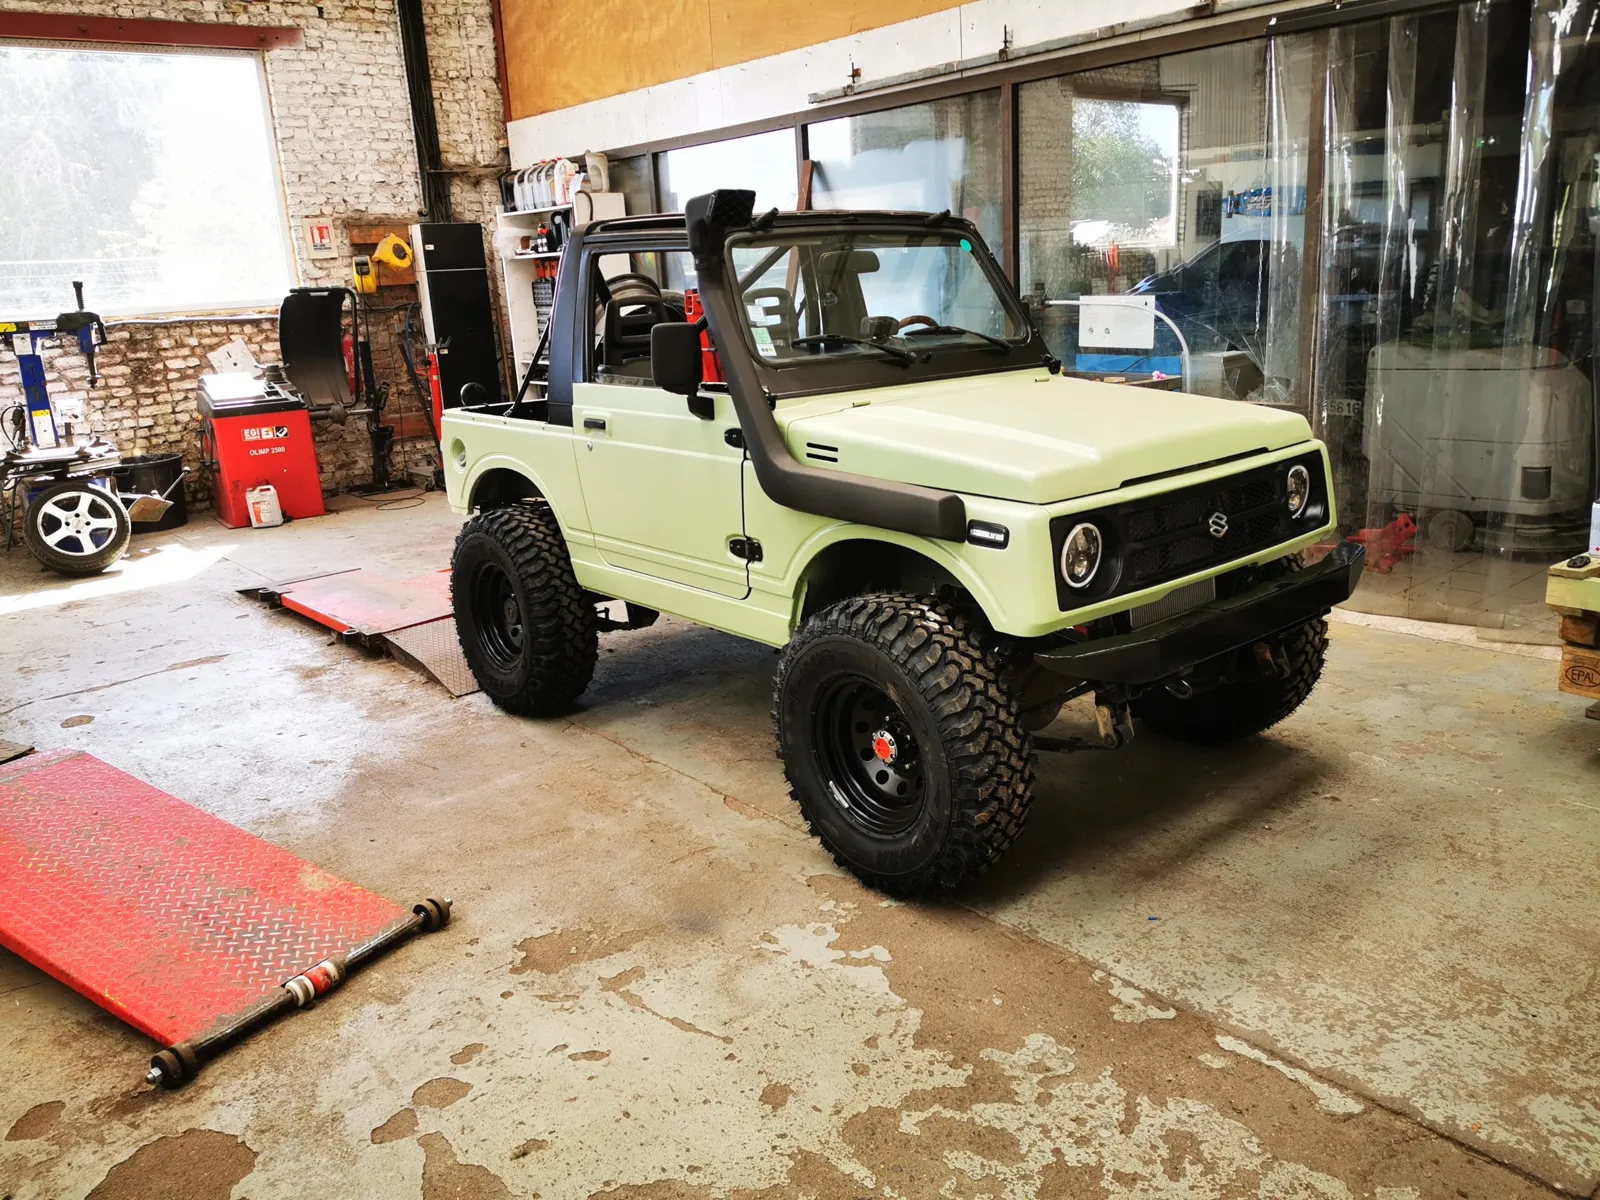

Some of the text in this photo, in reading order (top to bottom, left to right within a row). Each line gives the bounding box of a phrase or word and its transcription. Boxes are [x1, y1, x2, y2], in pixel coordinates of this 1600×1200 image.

[249, 446, 286, 456] OLIMP 2500
[1571, 668, 1597, 685] EPAL
